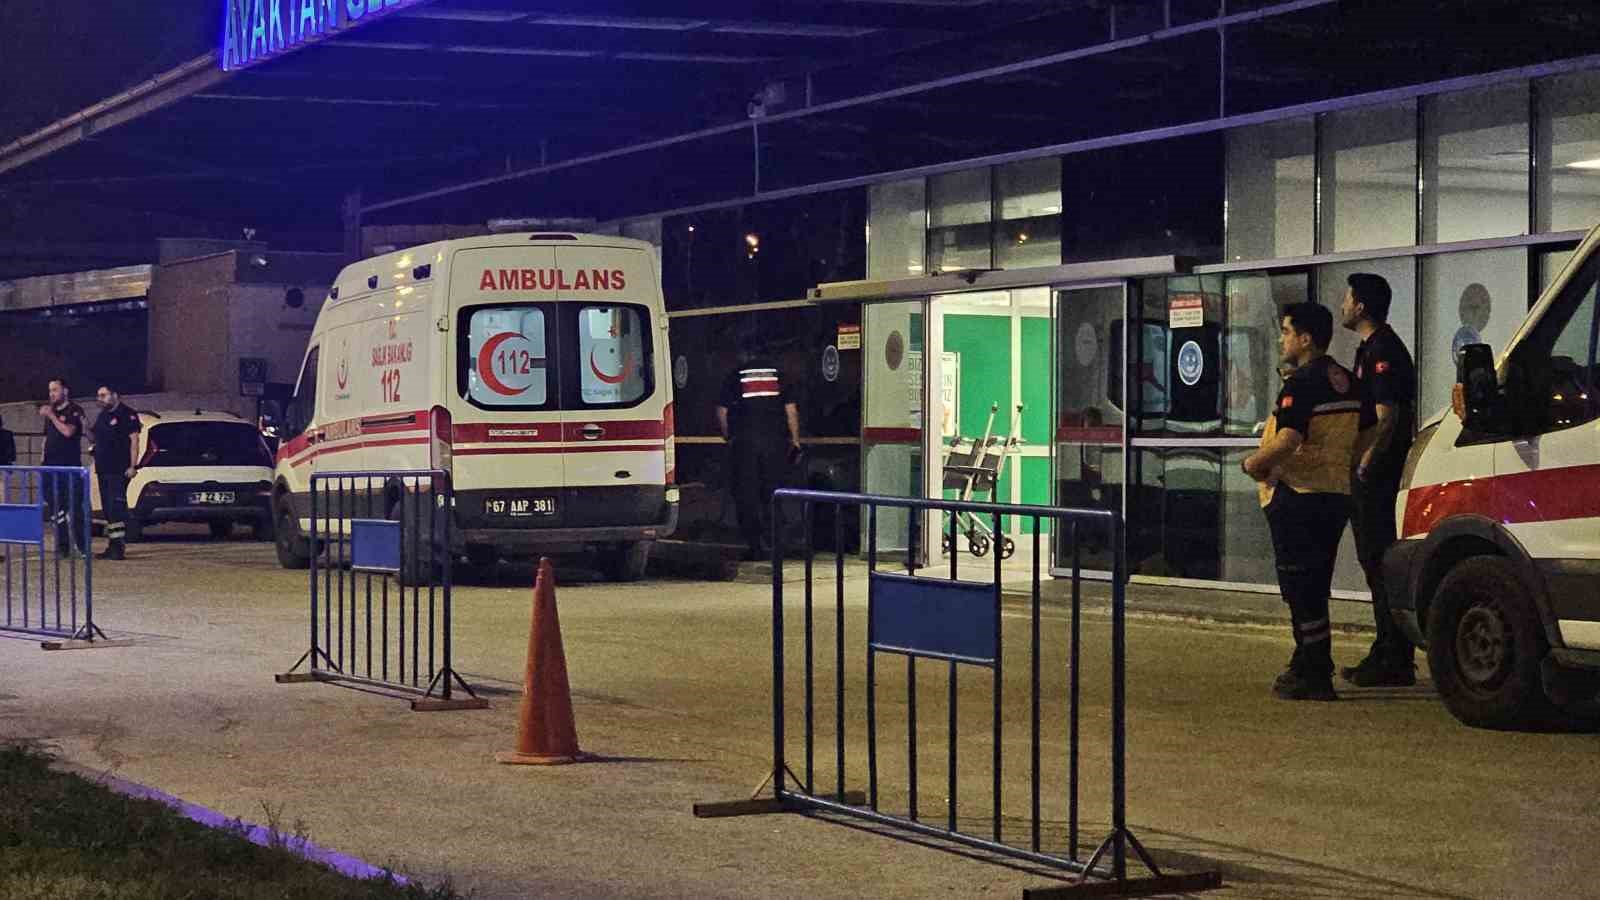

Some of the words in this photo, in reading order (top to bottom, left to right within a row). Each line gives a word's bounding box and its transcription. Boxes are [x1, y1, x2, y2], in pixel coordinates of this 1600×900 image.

[480, 269, 626, 290] AMBULANS
[499, 350, 530, 375] 112
[381, 369, 401, 403] 112
[492, 500, 505, 512] 67
[510, 500, 529, 511] AAP
[533, 499, 552, 511] 381
